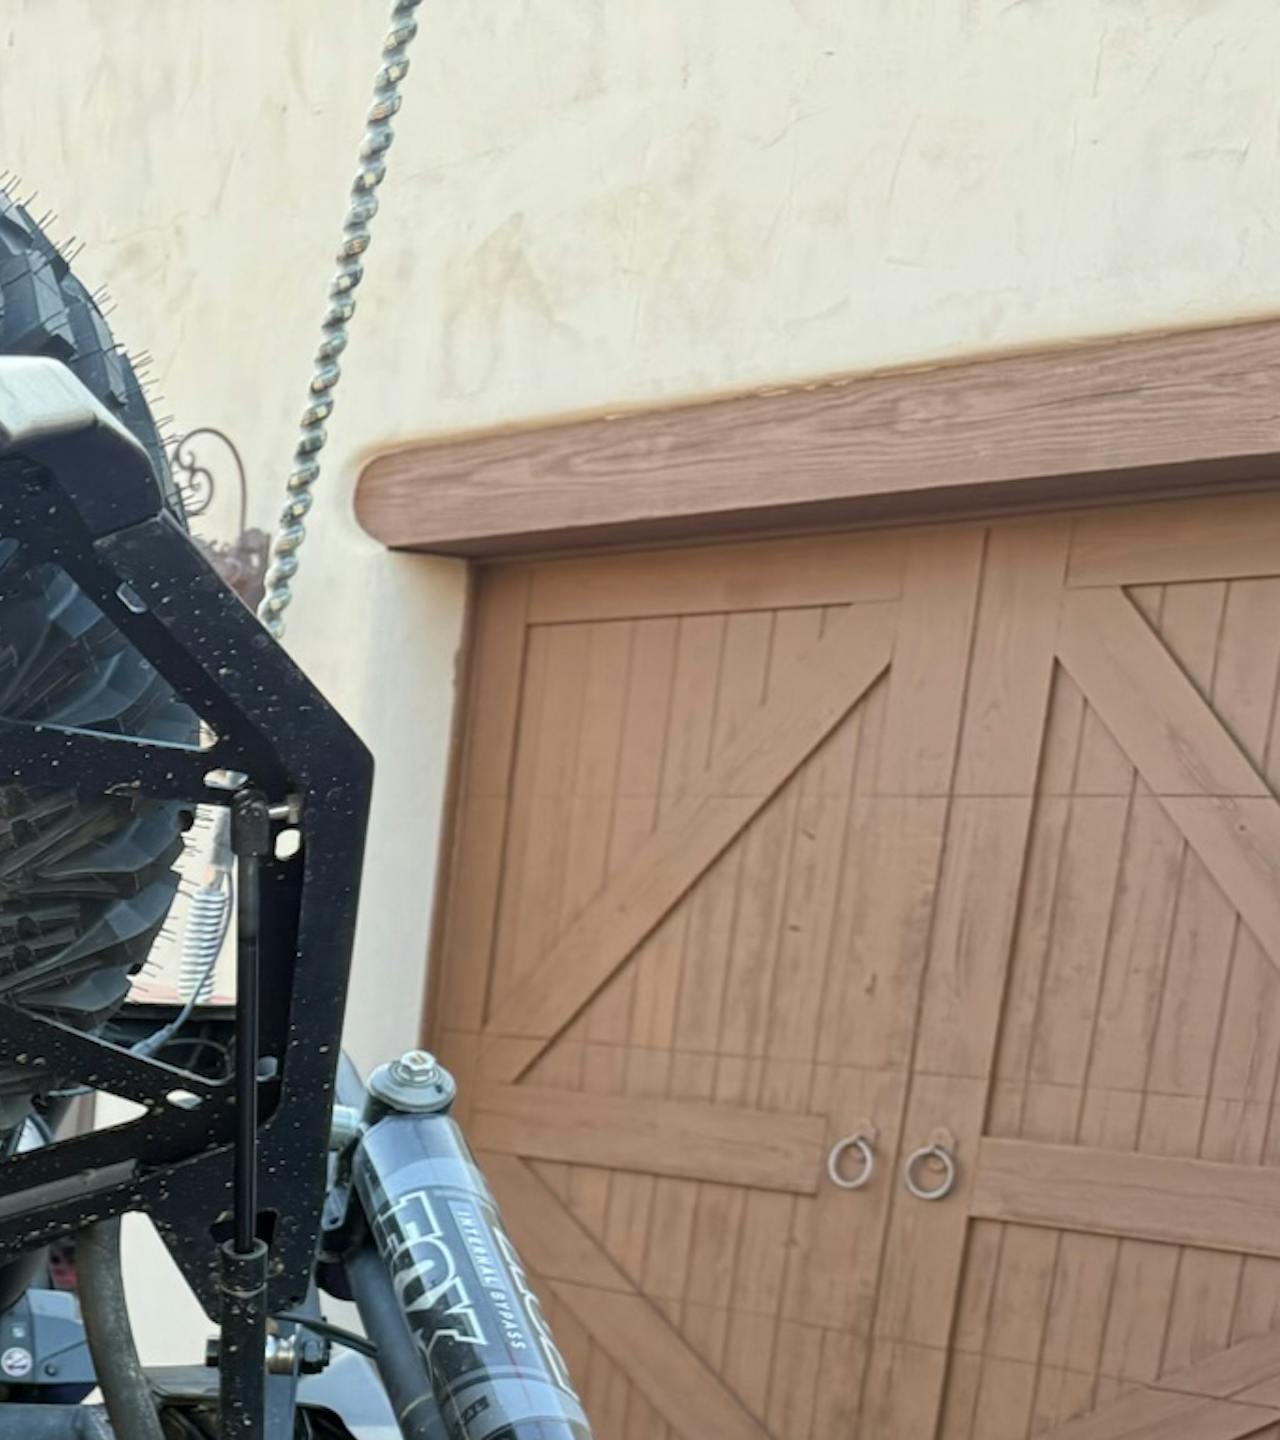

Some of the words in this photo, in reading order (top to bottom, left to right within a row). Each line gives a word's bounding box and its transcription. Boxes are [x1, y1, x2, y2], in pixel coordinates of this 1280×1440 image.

[372, 1189, 489, 1362] FOX
[456, 1210, 498, 1286] INTERNAL
[490, 1287, 527, 1350] BYPASS
